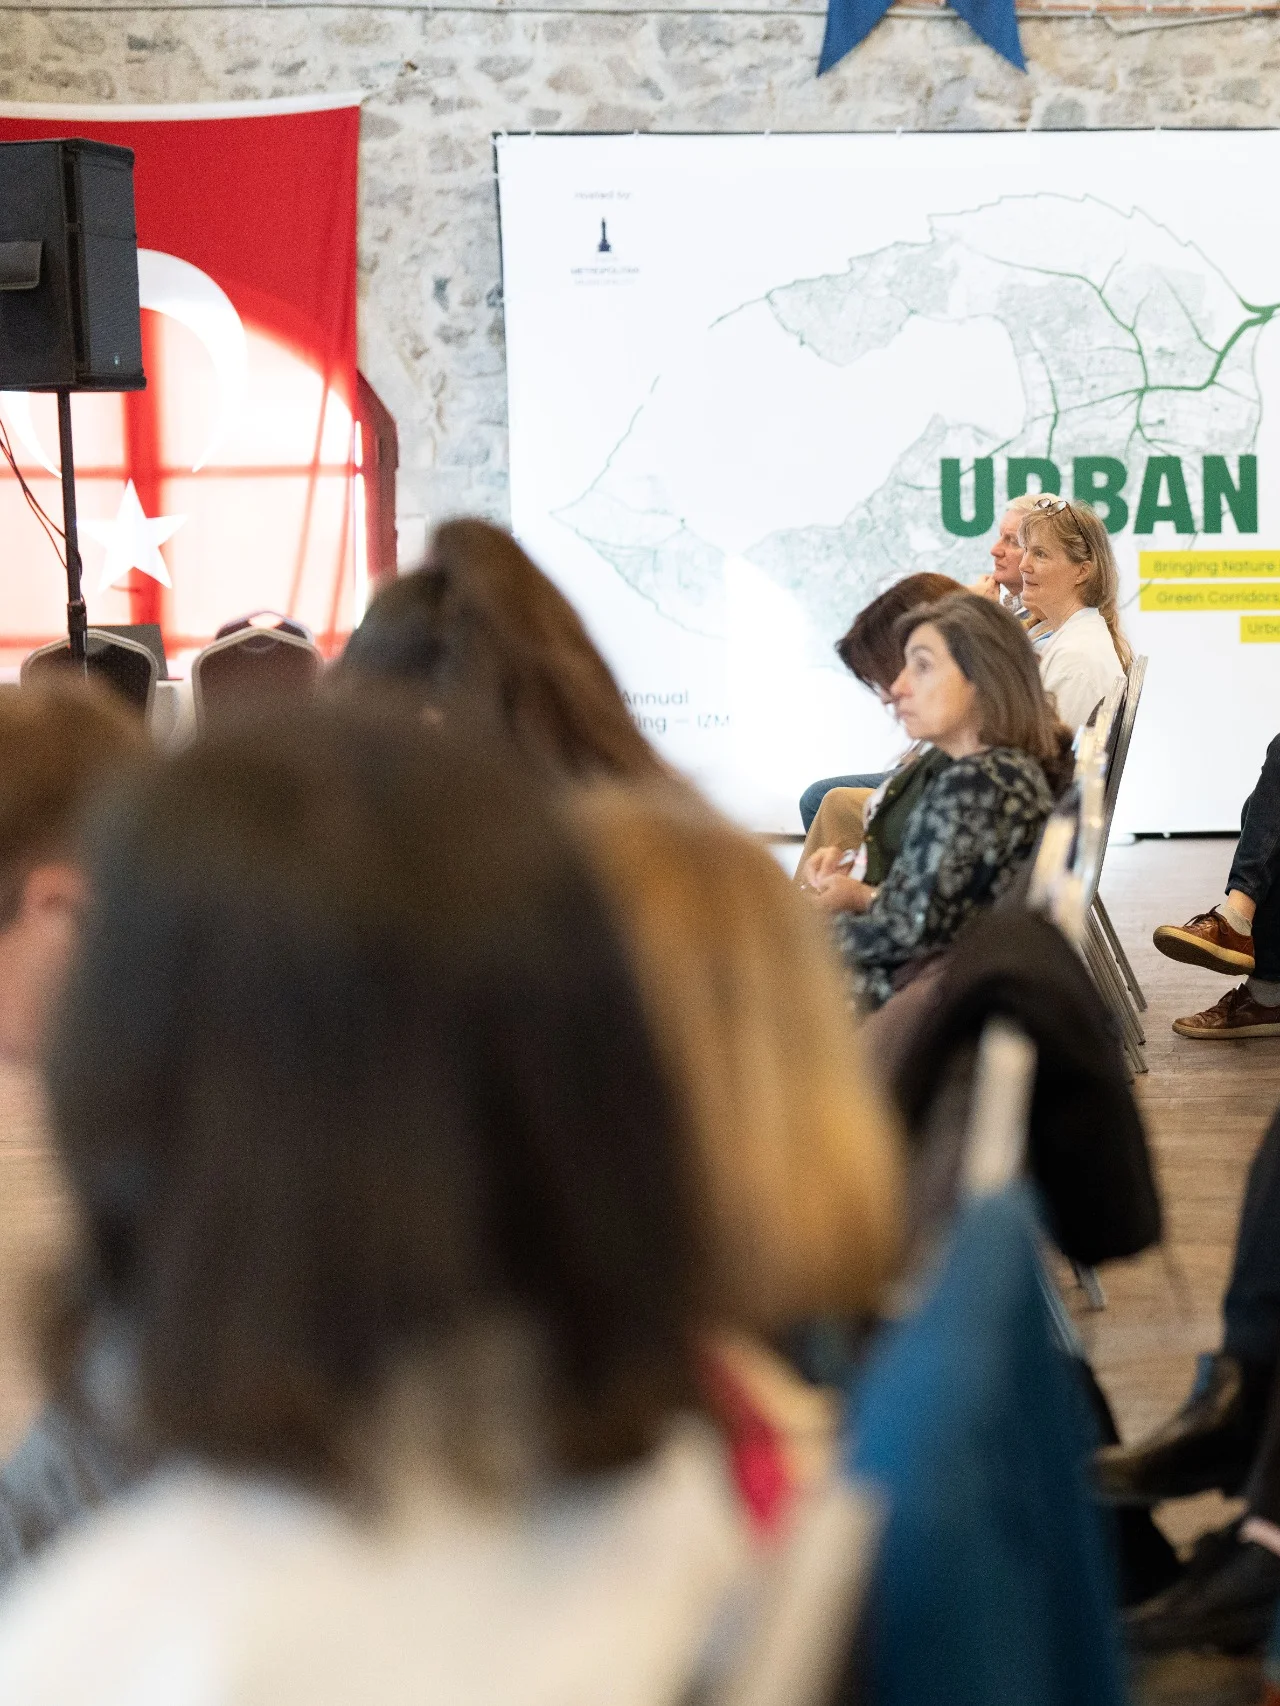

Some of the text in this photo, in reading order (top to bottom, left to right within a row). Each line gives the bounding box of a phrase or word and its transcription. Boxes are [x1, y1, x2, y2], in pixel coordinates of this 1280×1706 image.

[940, 455, 1258, 537] URBAN
[1153, 559, 1218, 576] Bringing
[1222, 559, 1274, 572] Nature
[1156, 591, 1204, 604] Green
[622, 690, 689, 705] Annual
